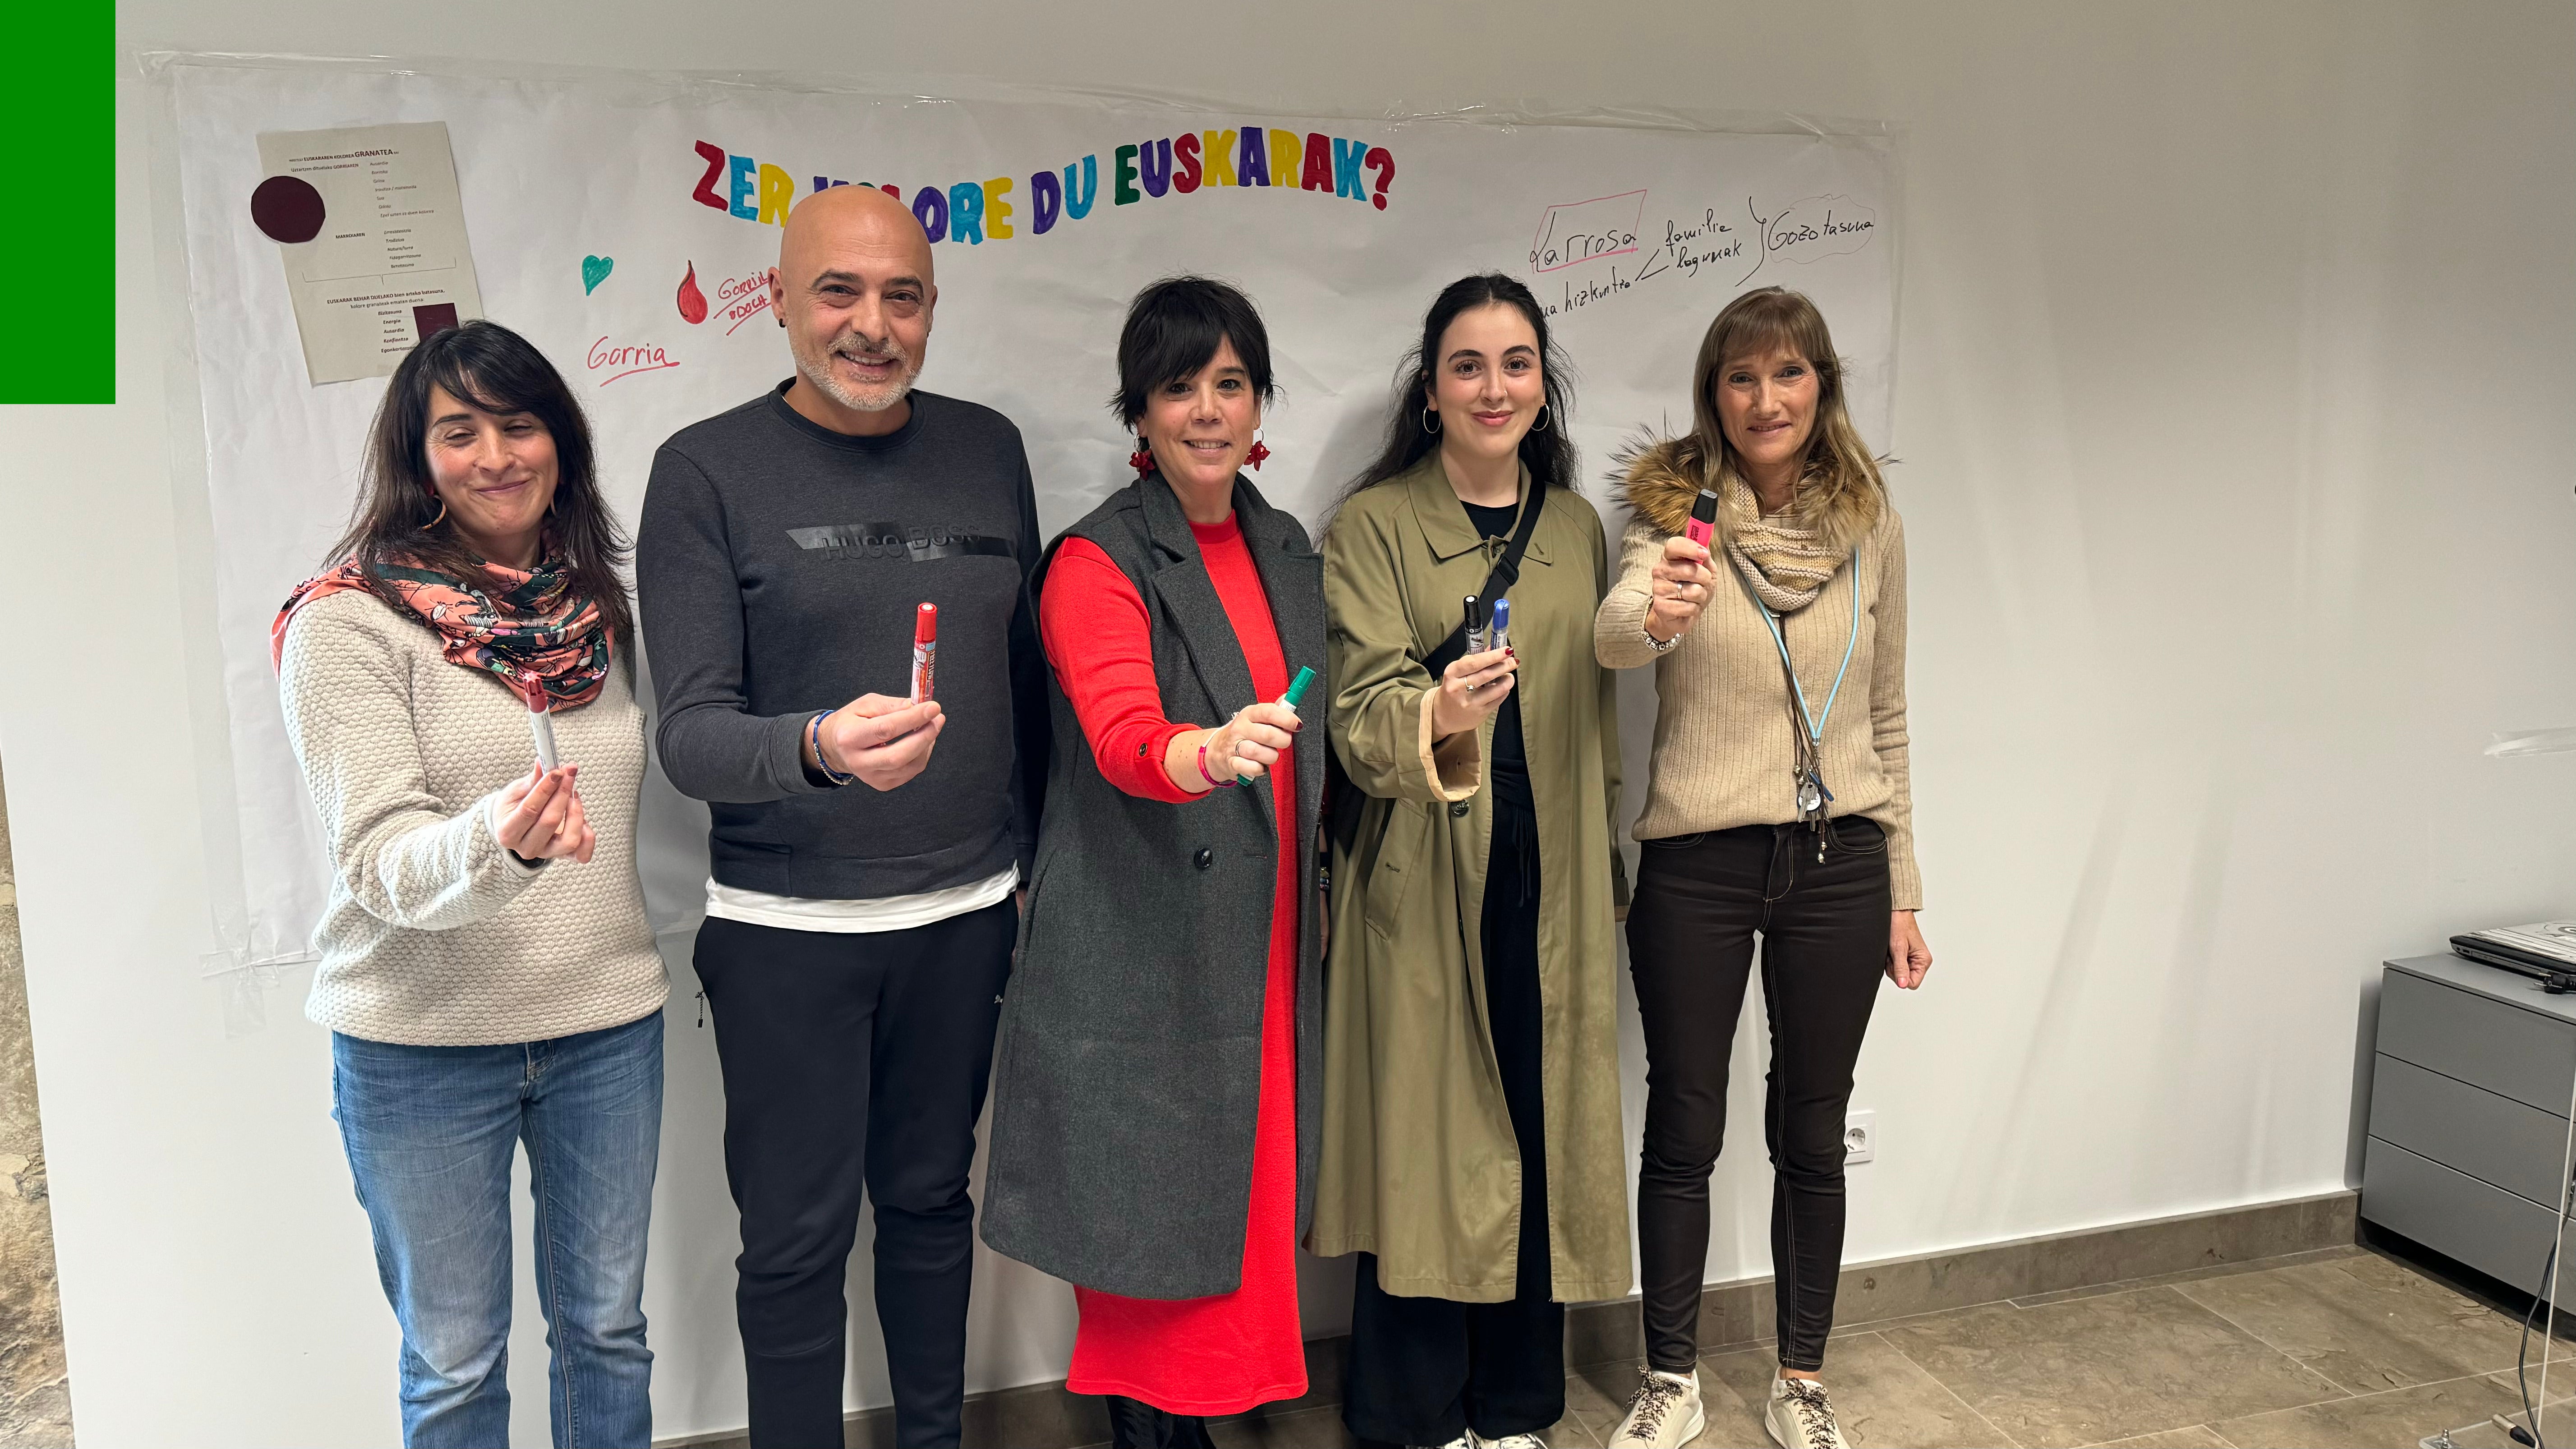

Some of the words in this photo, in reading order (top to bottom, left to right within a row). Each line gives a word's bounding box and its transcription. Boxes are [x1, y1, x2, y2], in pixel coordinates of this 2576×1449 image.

[354, 149, 393, 158] GRANATEA
[693, 140, 794, 228] ZER
[814, 176, 1013, 245] ORE
[1031, 154, 1098, 235] DU
[1115, 127, 1395, 211] EUSKARAK?
[588, 336, 680, 370] Gorria
[821, 535, 904, 560] HUGO
[907, 523, 982, 550] BOSS
